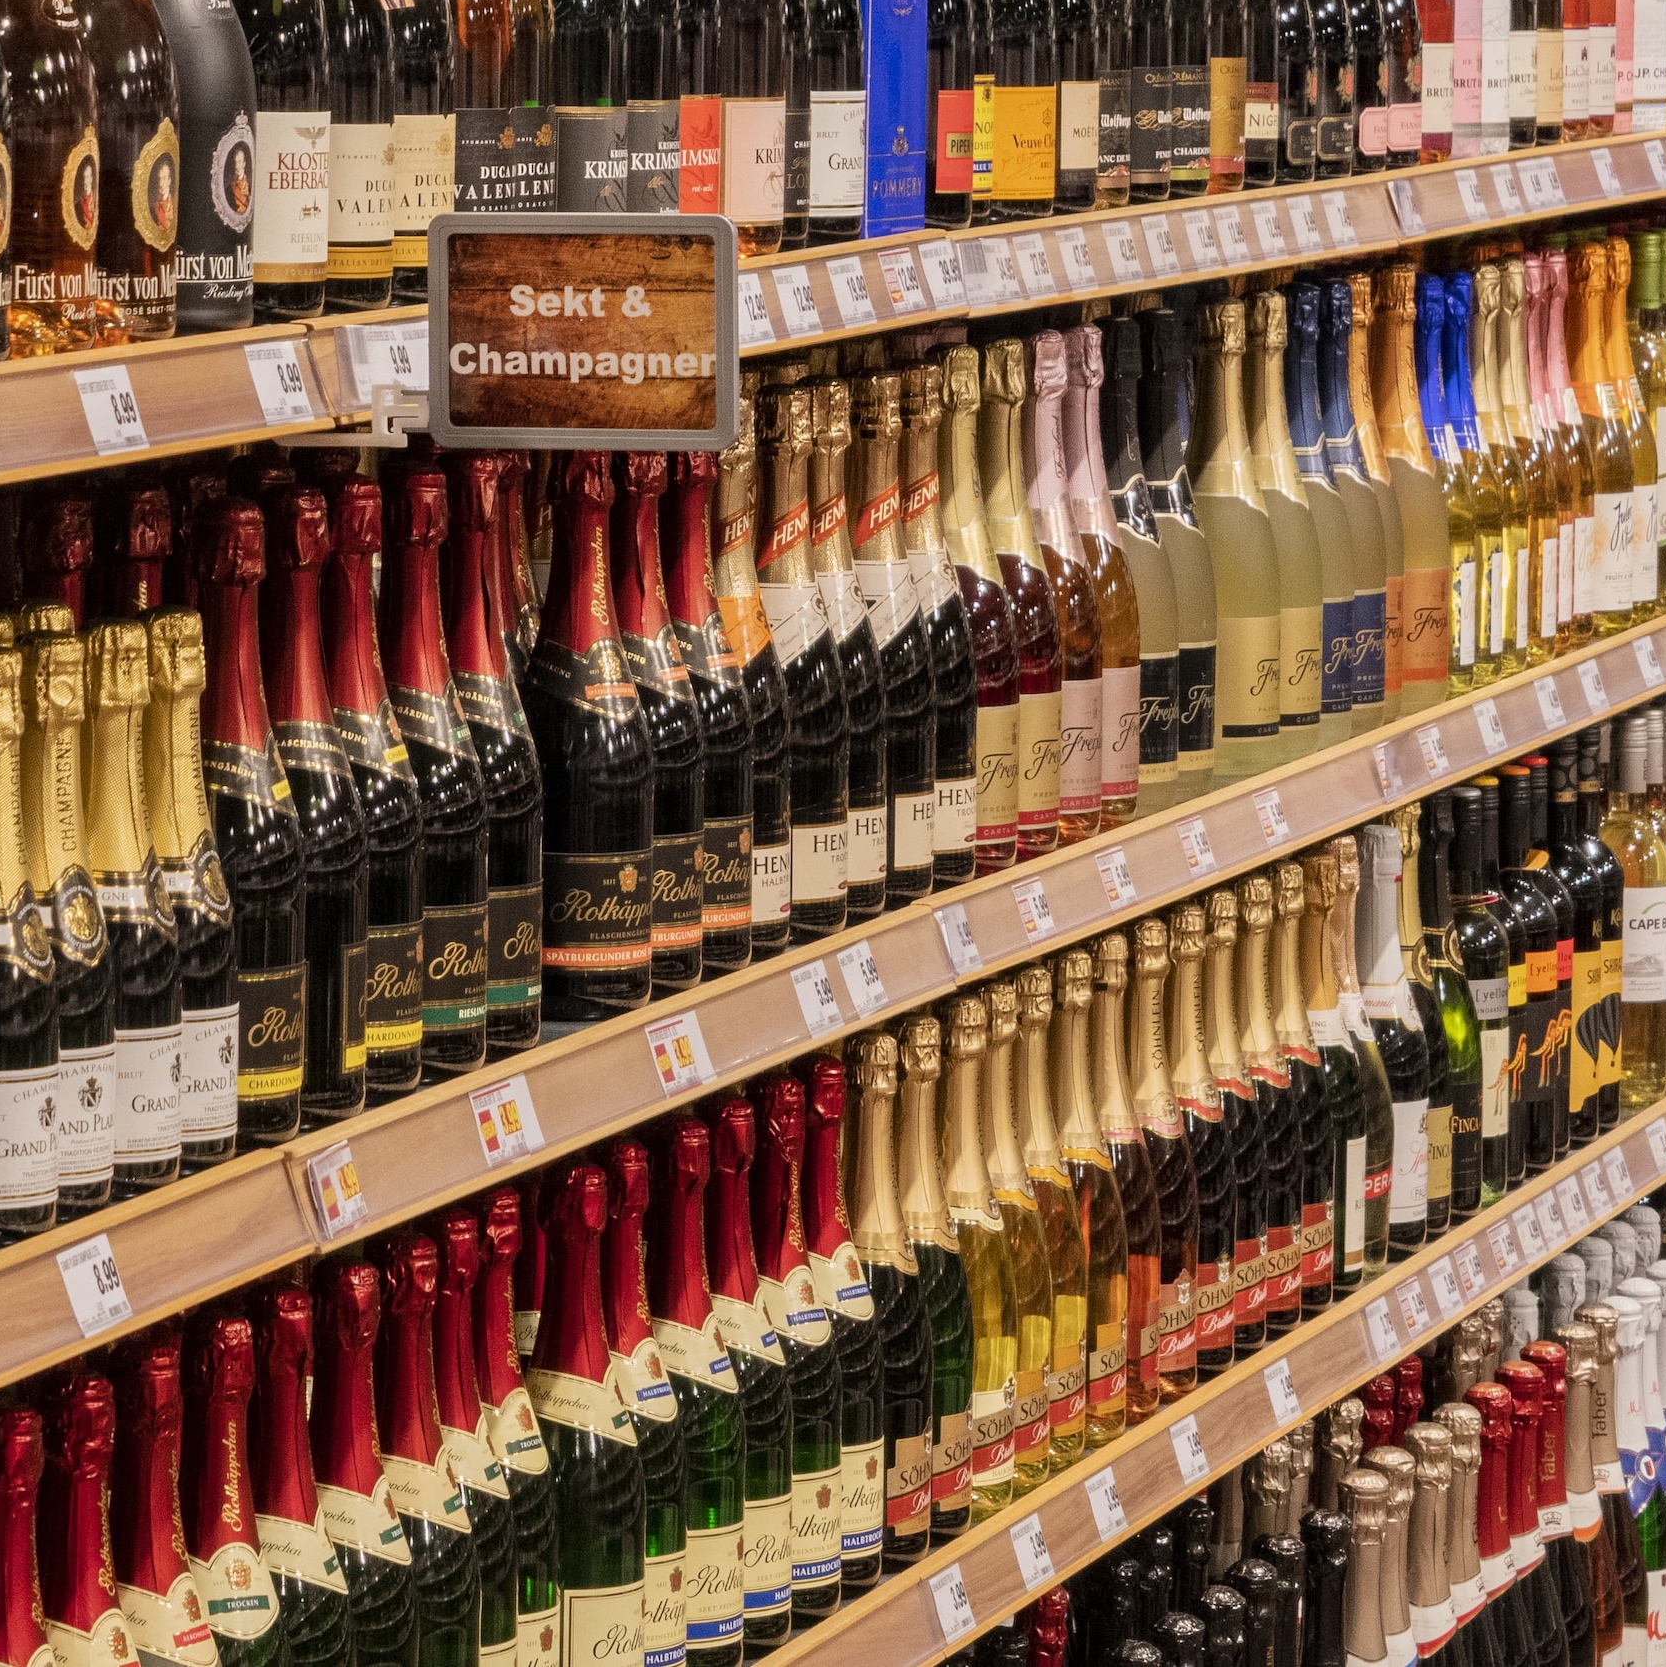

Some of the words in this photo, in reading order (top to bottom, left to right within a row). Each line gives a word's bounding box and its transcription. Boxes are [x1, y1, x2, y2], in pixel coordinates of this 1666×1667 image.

[1012, 134, 1041, 150] Veuve
[414, 174, 446, 188] DUCA
[480, 164, 511, 180] DUCA
[516, 161, 548, 178] DUCA
[13, 263, 54, 303] Fürst
[57, 271, 84, 302] von
[211, 253, 235, 282] von
[97, 268, 129, 303] ürst
[132, 271, 158, 301] von
[508, 284, 606, 318] Sekt
[621, 286, 653, 319] &
[276, 360, 305, 395] 8.99
[388, 345, 414, 375] 9.99
[448, 342, 717, 386] Champagner
[109, 391, 139, 426] 8.99
[589, 526, 608, 627] Rotkäppchen
[193, 704, 208, 818] CHAMPAGNE
[62, 734, 80, 852] CHAMPAGNE
[1628, 917, 1656, 932] CAPE
[545, 949, 632, 964] SPÄTBURGUNDER
[814, 977, 834, 1007] 5.99
[117, 1070, 143, 1081] BRUT
[90, 1257, 122, 1297] 8.99
[221, 1419, 244, 1533] Rotkäppchen
[98, 1484, 117, 1597] Rotkäppchen
[226, 1597, 261, 1611] TROCKEN
